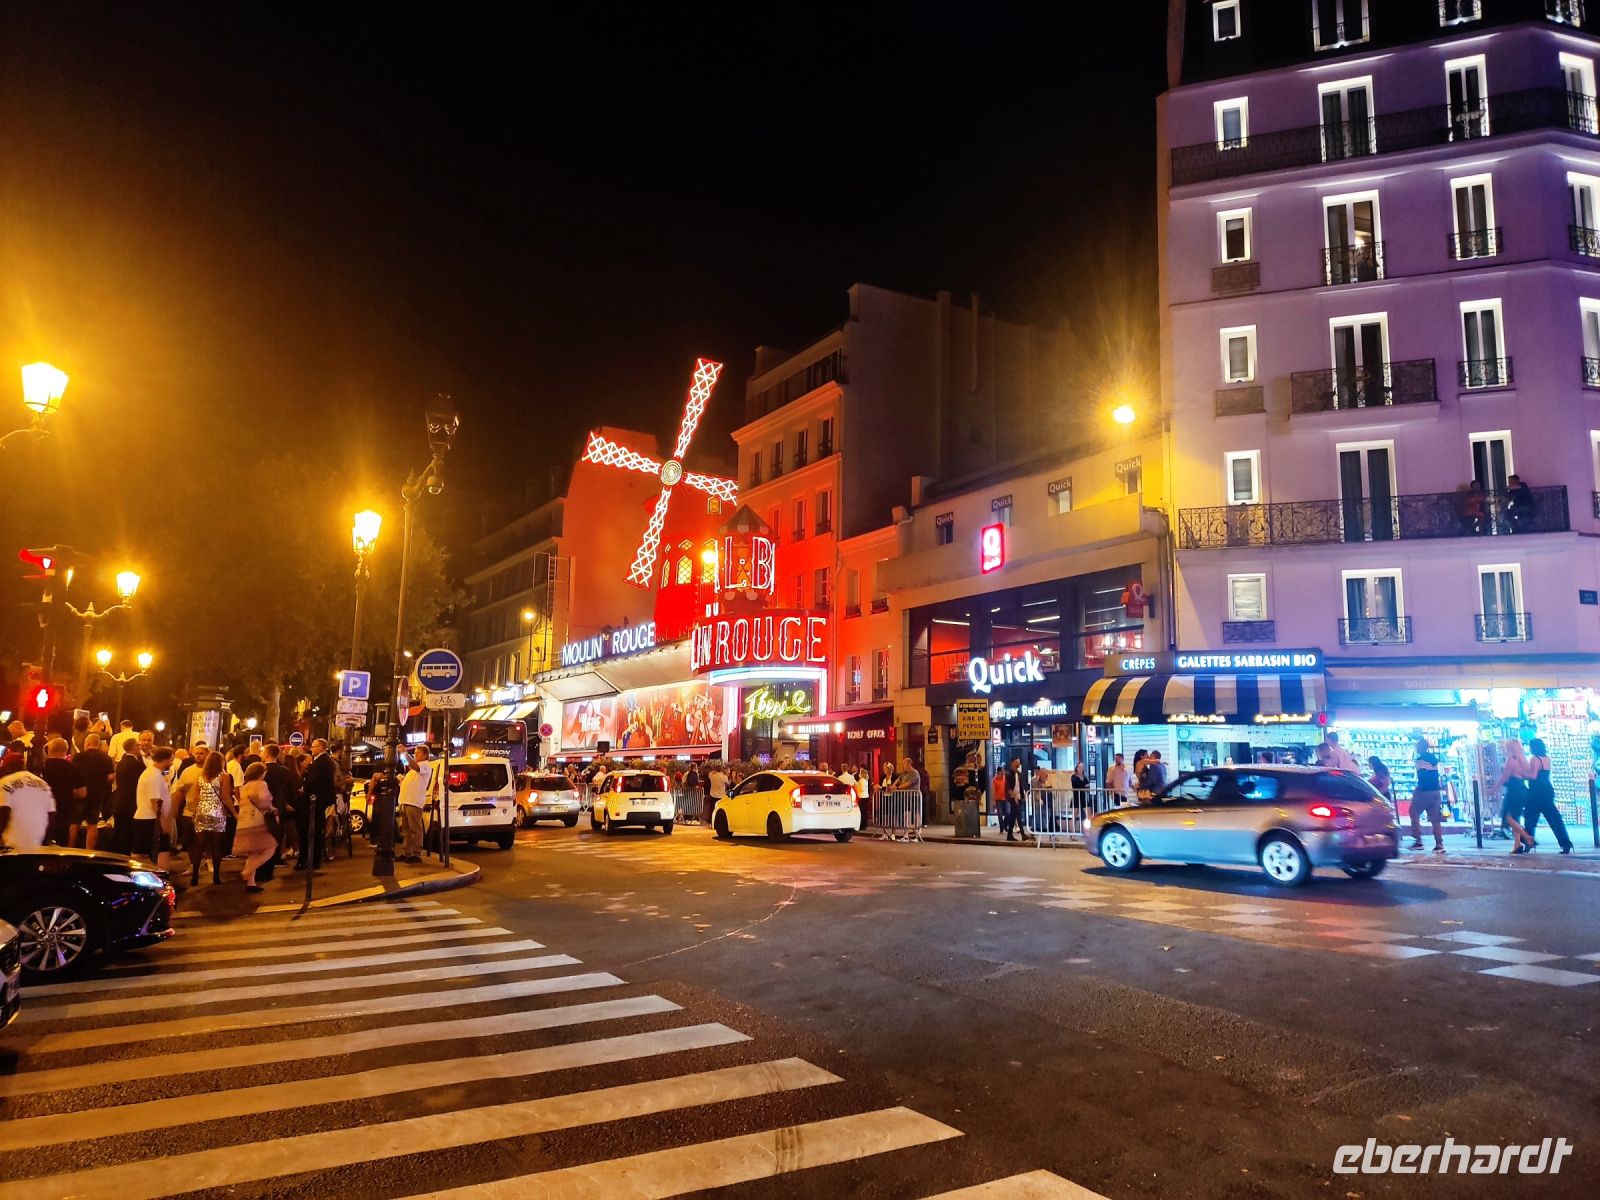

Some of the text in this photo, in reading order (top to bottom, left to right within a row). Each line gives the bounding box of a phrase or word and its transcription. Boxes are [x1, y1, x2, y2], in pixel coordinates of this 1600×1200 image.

[1116, 458, 1142, 474] Quick
[1049, 479, 1071, 493] Quick
[992, 497, 1012, 509] Quick
[936, 514, 954, 526] Quick
[562, 621, 656, 666] MOULIN ROUGE
[715, 616, 827, 665] ROUGE
[1122, 657, 1156, 670] CRÊPES
[1178, 654, 1317, 668] GALETTES SARRASIN BIO
[969, 650, 1046, 693] Quick
[348, 676, 361, 693] P
[993, 703, 1067, 719] Burger Restaurant
[866, 729, 886, 739] OFFICE
